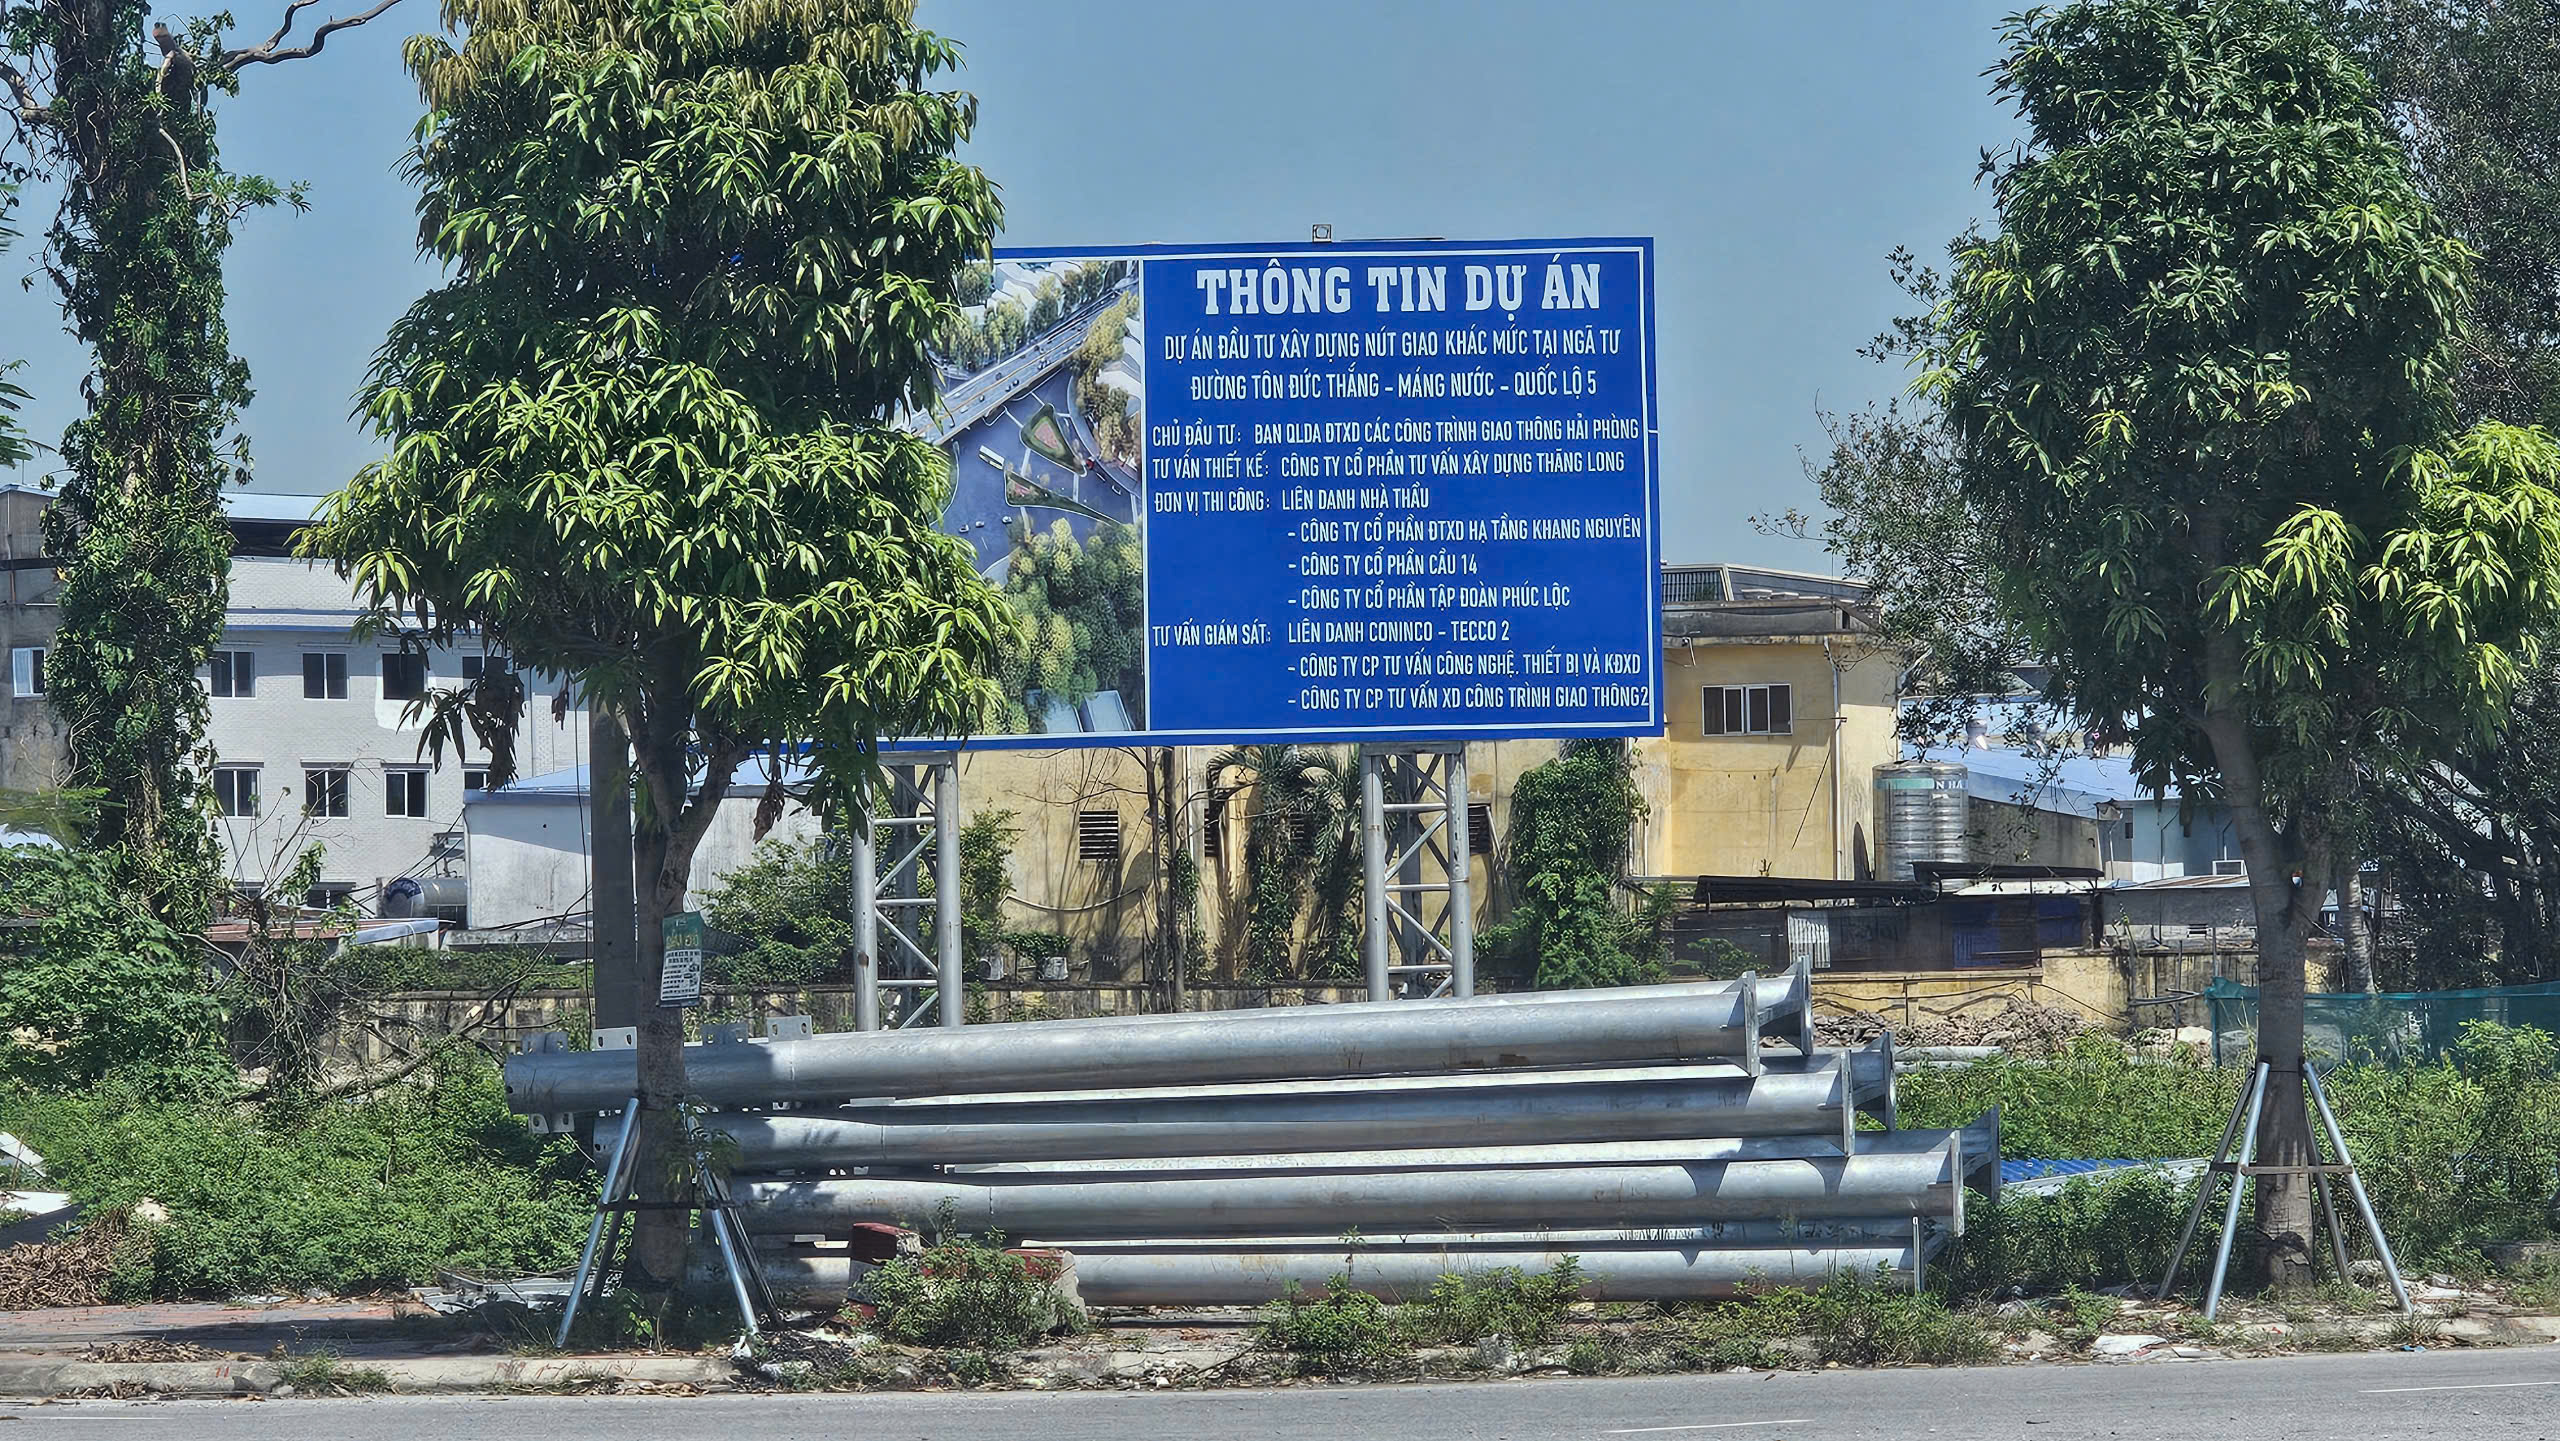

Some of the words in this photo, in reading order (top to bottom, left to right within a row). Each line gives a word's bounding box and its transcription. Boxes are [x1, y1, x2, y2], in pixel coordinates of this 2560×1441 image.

[1196, 258, 1351, 315] THÔNG
[1367, 266, 1447, 312] TIN
[1464, 264, 1527, 322] DỰ
[1541, 253, 1601, 310] ÁN
[1165, 334, 1187, 365] DỰ
[1191, 327, 1213, 360] ÁN
[1217, 326, 1249, 359] ĐẦU
[1253, 333, 1276, 359] TƯ
[1280, 327, 1310, 359] XÂY
[1315, 332, 1360, 363] DỰNG
[1365, 325, 1397, 357] NÚT
[1401, 331, 1438, 357] GIAO
[1445, 323, 1488, 355] KHÁC
[1492, 323, 1528, 355] MỨC
[1532, 329, 1558, 359] TẠI
[1563, 324, 1596, 355] NGÃ
[1599, 329, 1621, 355] TƯ
[1190, 368, 1247, 401] ĐƯỜNG
[1251, 368, 1284, 400] TÔN
[1287, 367, 1321, 399] ĐỨC
[1325, 361, 1379, 398] THẮNG
[1398, 367, 1445, 398] MÁNG
[1450, 366, 1495, 397] NƯỚC
[1514, 363, 1558, 396] QUỐC
[1562, 364, 1582, 400] LỘ
[1587, 370, 1597, 395] 5
[1152, 418, 1180, 447] CHỦ
[1184, 417, 1212, 446] ĐẦU
[1254, 423, 1282, 445] BAN
[1286, 423, 1322, 444] QLDA
[1325, 421, 1360, 443] ĐTXD
[1364, 416, 1391, 443] CÁC
[1394, 417, 1432, 443] CÔNG
[1435, 415, 1477, 443] TRÌNH
[1481, 420, 1512, 442] GIAO
[1515, 415, 1562, 441] THÔNG
[1566, 412, 1589, 440] HẢI
[1593, 413, 1639, 440] PHÒNG
[1152, 457, 1171, 479] TƯ
[1173, 448, 1200, 479] VẤN
[1203, 449, 1242, 478] THIẾT
[1281, 452, 1319, 477] CÔNG
[1323, 455, 1340, 477] TY
[1344, 446, 1364, 476] CỔ
[1367, 448, 1404, 476] PHẦN
[1407, 454, 1428, 475] TƯ
[1430, 446, 1459, 475] VẤN
[1463, 449, 1490, 475] XÂY
[1493, 452, 1532, 478] DỰNG
[1535, 448, 1583, 473] THĂNG
[1587, 451, 1625, 472] LONG
[1154, 491, 1182, 513] ĐƠN
[1185, 491, 1199, 517] VỊ
[1202, 490, 1224, 512] THI
[1228, 486, 1270, 512] CÔNG:
[1282, 485, 1313, 511] LIÊN
[1318, 488, 1356, 510] DANH
[1360, 482, 1389, 510] NHÀ
[1301, 517, 1339, 543] CÔNG
[1342, 521, 1360, 542] TY
[1364, 511, 1384, 542] CỔ
[1386, 513, 1424, 542] PHẦN
[1428, 520, 1465, 541] ĐTXD
[1469, 519, 1488, 544] HẠ
[1490, 513, 1528, 541] TẦNG
[1532, 518, 1581, 540] KHANG
[1585, 513, 1641, 539] NGUYÊN
[1301, 551, 1339, 576] CÔNG
[1343, 554, 1361, 576] TY
[1364, 545, 1385, 576] CỔ
[1387, 547, 1425, 575] PHẦN
[1461, 553, 1478, 575] 14
[1301, 584, 1340, 610] CÔNG
[1343, 588, 1361, 609] TY
[1365, 579, 1385, 609] CỔ
[1387, 580, 1425, 609] PHẦN
[1428, 583, 1456, 612] TẬP
[1459, 581, 1498, 608] ĐOÀN
[1502, 579, 1539, 607] PHÚC
[1543, 581, 1570, 611] LỘC
[1151, 625, 1171, 647] TƯ
[1173, 617, 1200, 646] VẤN
[1204, 618, 1238, 646] GIÁM
[1288, 617, 1321, 643] LIÊN
[1325, 621, 1364, 643] DANH
[1369, 621, 1433, 642] CONINCO
[1450, 620, 1497, 642] TECCO
[1501, 620, 1510, 641] 2
[1300, 652, 1337, 677] CÔNG
[1341, 655, 1358, 677] TY
[1362, 655, 1380, 677] CP
[1382, 655, 1402, 676] TƯ
[1404, 646, 1432, 676] VẤN
[1436, 650, 1474, 675] CÔNG
[1522, 645, 1562, 674] THIẾT
[1566, 653, 1579, 677] BỊ
[1582, 646, 1601, 674] VÀ
[1604, 653, 1641, 674] KĐXD
[1301, 685, 1340, 710] CÔNG
[1343, 688, 1361, 709] TY
[1365, 688, 1384, 709] CP
[1387, 687, 1407, 709] TƯ
[1409, 679, 1438, 709] VẤN
[1442, 687, 1461, 708] XD
[1465, 683, 1504, 708] CÔNG
[1507, 681, 1551, 708] TRÌNH
[1555, 686, 1588, 708] GIAO
